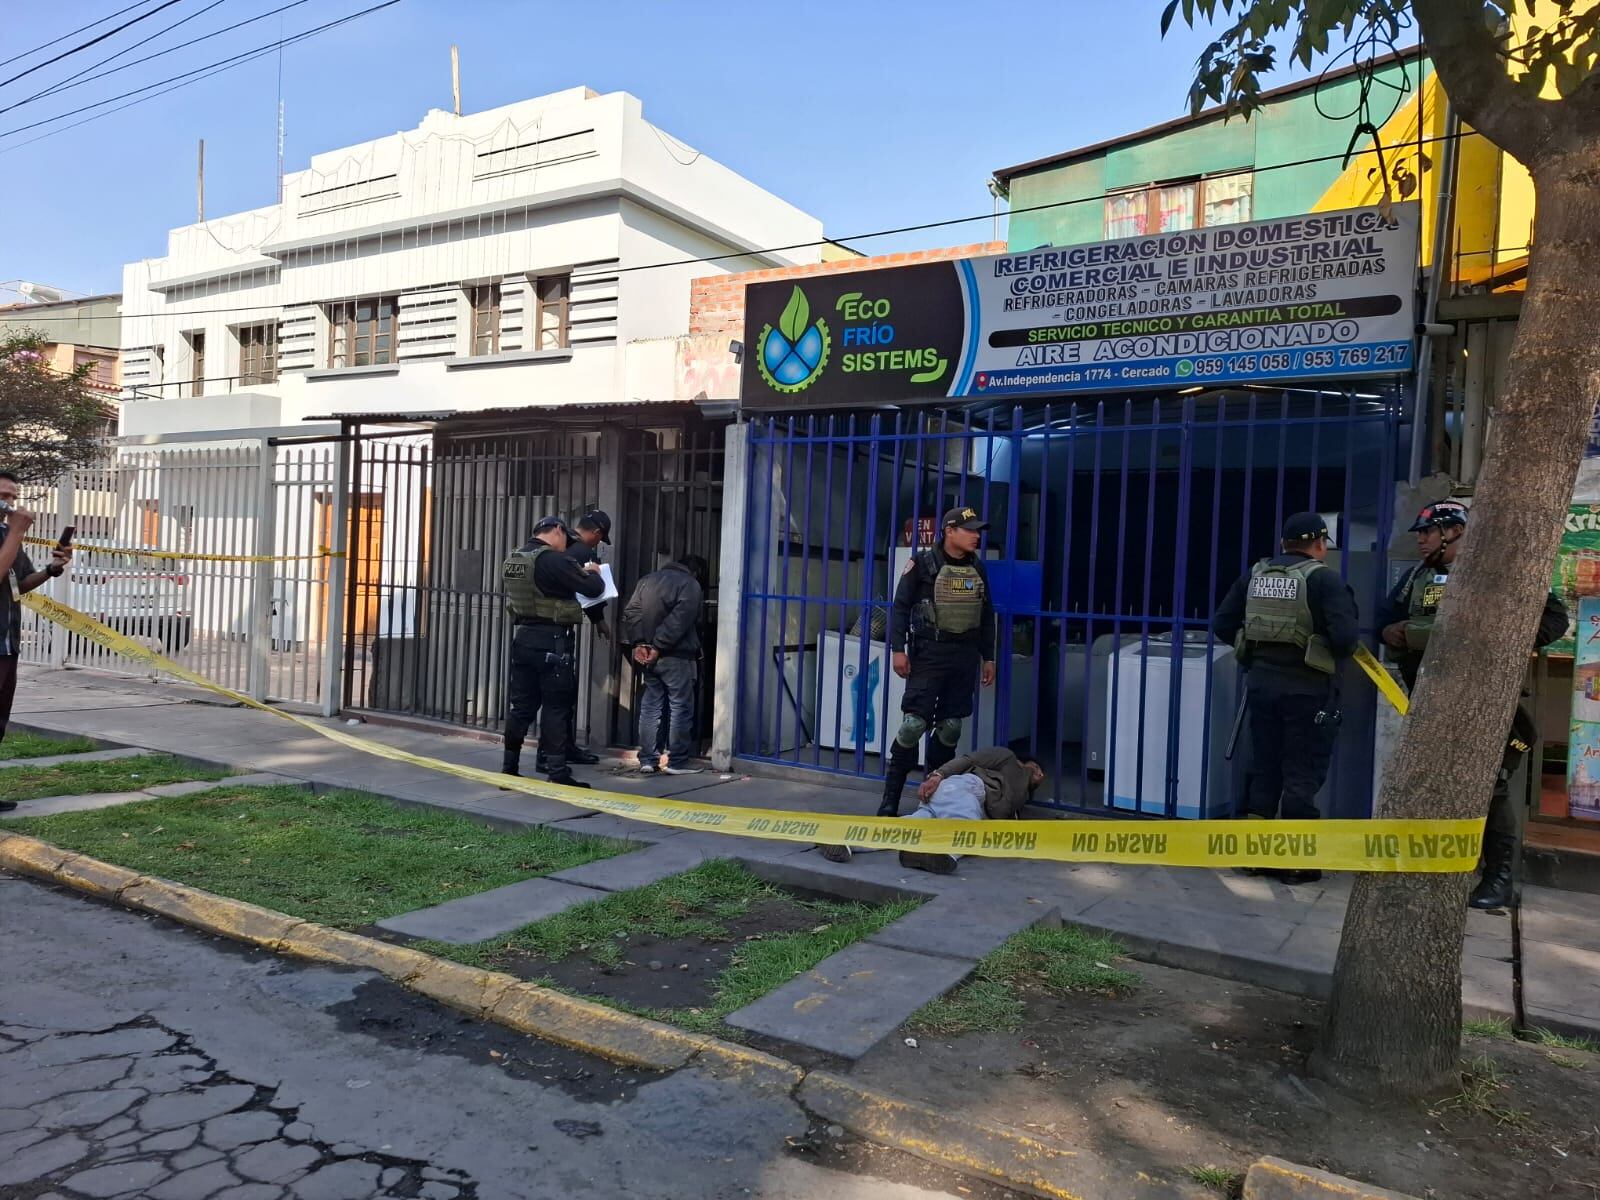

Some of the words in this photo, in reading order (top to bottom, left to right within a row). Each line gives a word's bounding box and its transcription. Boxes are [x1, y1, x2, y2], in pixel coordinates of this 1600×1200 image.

[994, 232, 1207, 277] REFRIGERACIÓN
[1010, 261, 1162, 295] COMERCIAL
[1168, 258, 1188, 279] E
[1194, 236, 1384, 276] INDUSTRIAL
[1003, 285, 1138, 312] REFRIGERADORAS
[1154, 274, 1239, 296] CAMARAS
[1244, 258, 1386, 287] REFRIGERADAS
[843, 299, 891, 321] ECO
[1064, 296, 1193, 322] CONGELADORAS
[1210, 283, 1318, 309] LAVADORAS
[842, 320, 896, 347] FRÍO
[1028, 328, 1098, 343] SERVICIO
[1102, 317, 1172, 336] TECNICO
[1175, 316, 1188, 329] Y
[1191, 308, 1282, 328] GARANTIA
[1287, 303, 1346, 320] TOTAL
[1016, 342, 1081, 367] AIRE
[1093, 319, 1359, 361] ACONDICIONADO
[840, 348, 938, 373] SISTEMS
[1084, 368, 1111, 381] 1774
[1121, 365, 1170, 379] Cercado
[1195, 358, 1224, 375] 959
[1229, 356, 1257, 373] 145
[1261, 353, 1291, 370] 058
[1304, 350, 1334, 368] 953
[1339, 347, 1370, 365] 769
[1375, 345, 1408, 363] 217
[905, 531, 943, 543] VNT
[1251, 587, 1296, 599] HALCONES
[1253, 577, 1296, 590] POLICIA
